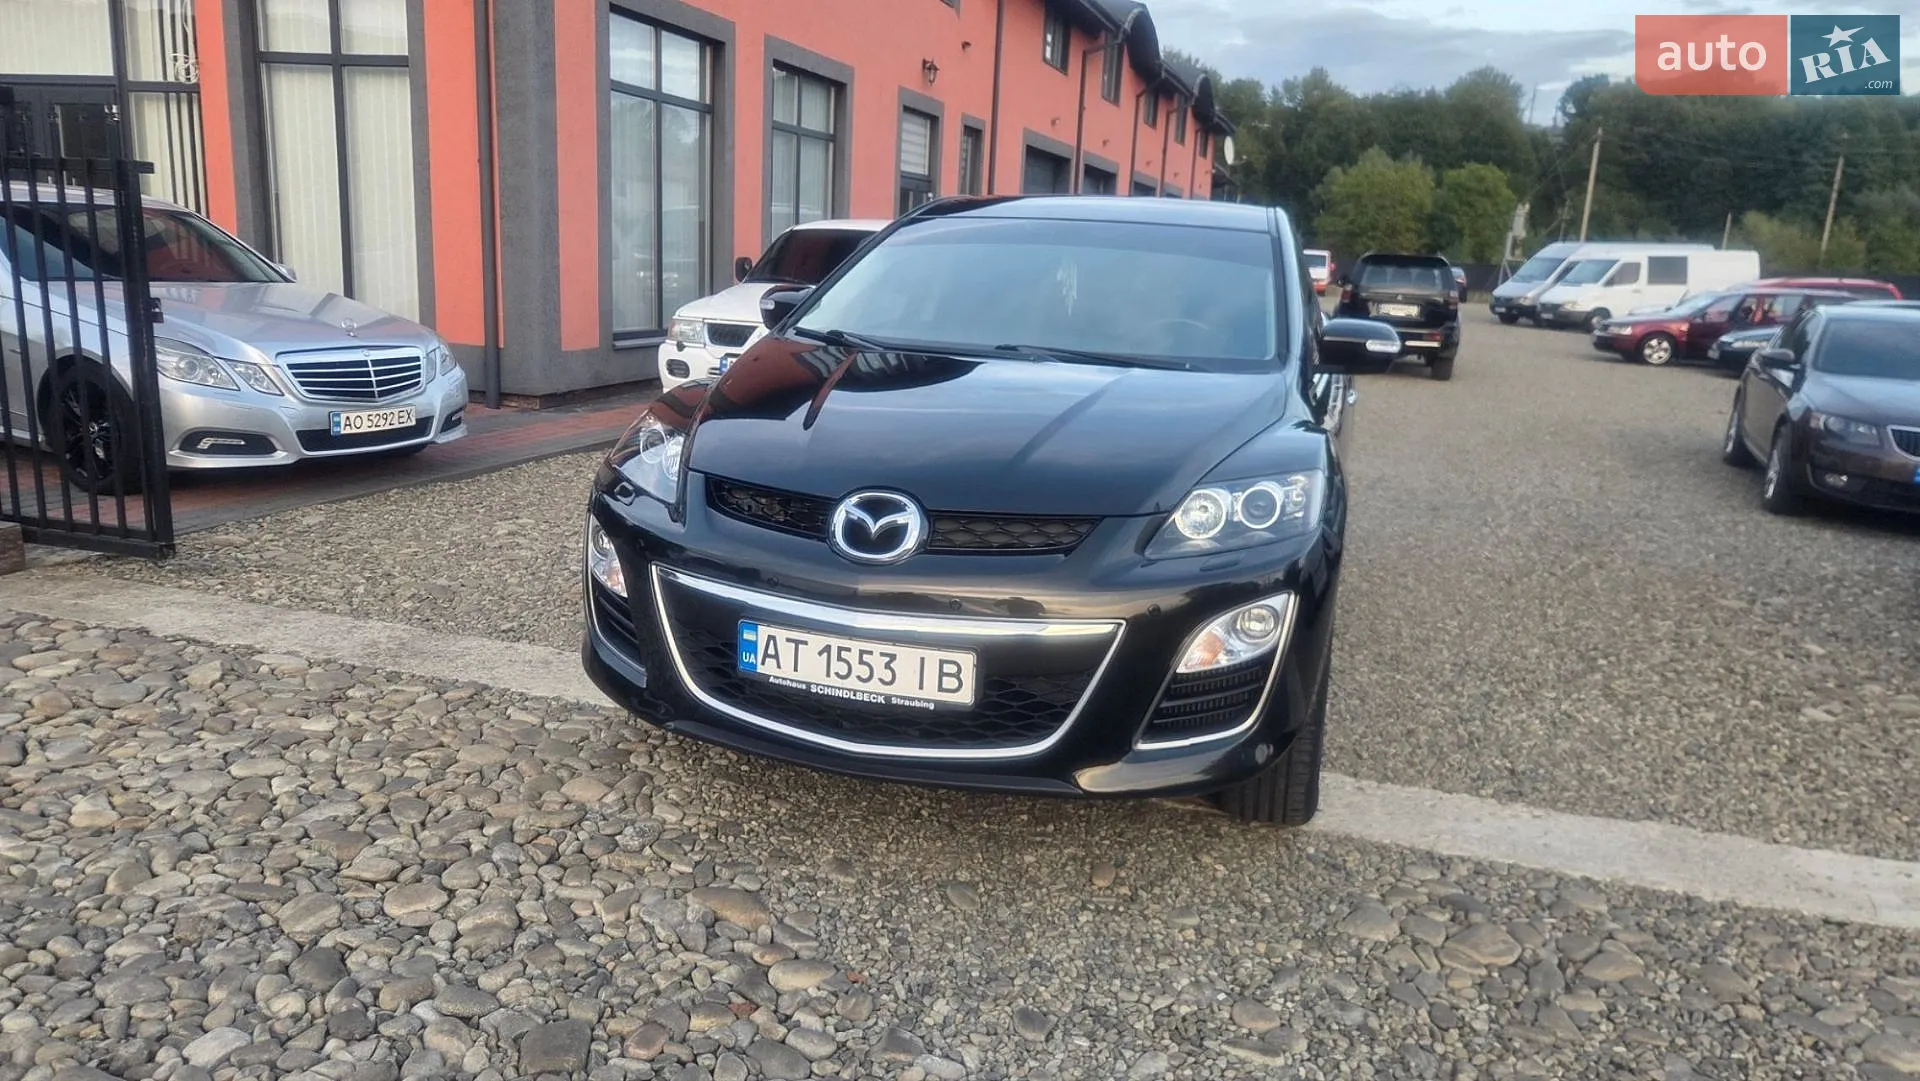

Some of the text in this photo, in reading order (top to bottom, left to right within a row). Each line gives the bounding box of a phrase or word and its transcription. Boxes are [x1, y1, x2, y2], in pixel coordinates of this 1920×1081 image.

[343, 409, 413, 431] AO 5292 EX
[742, 651, 756, 664] UA
[760, 634, 964, 693] AT 1553 IB
[769, 675, 935, 710] Autohaus SCHINDLBECK Straubing
